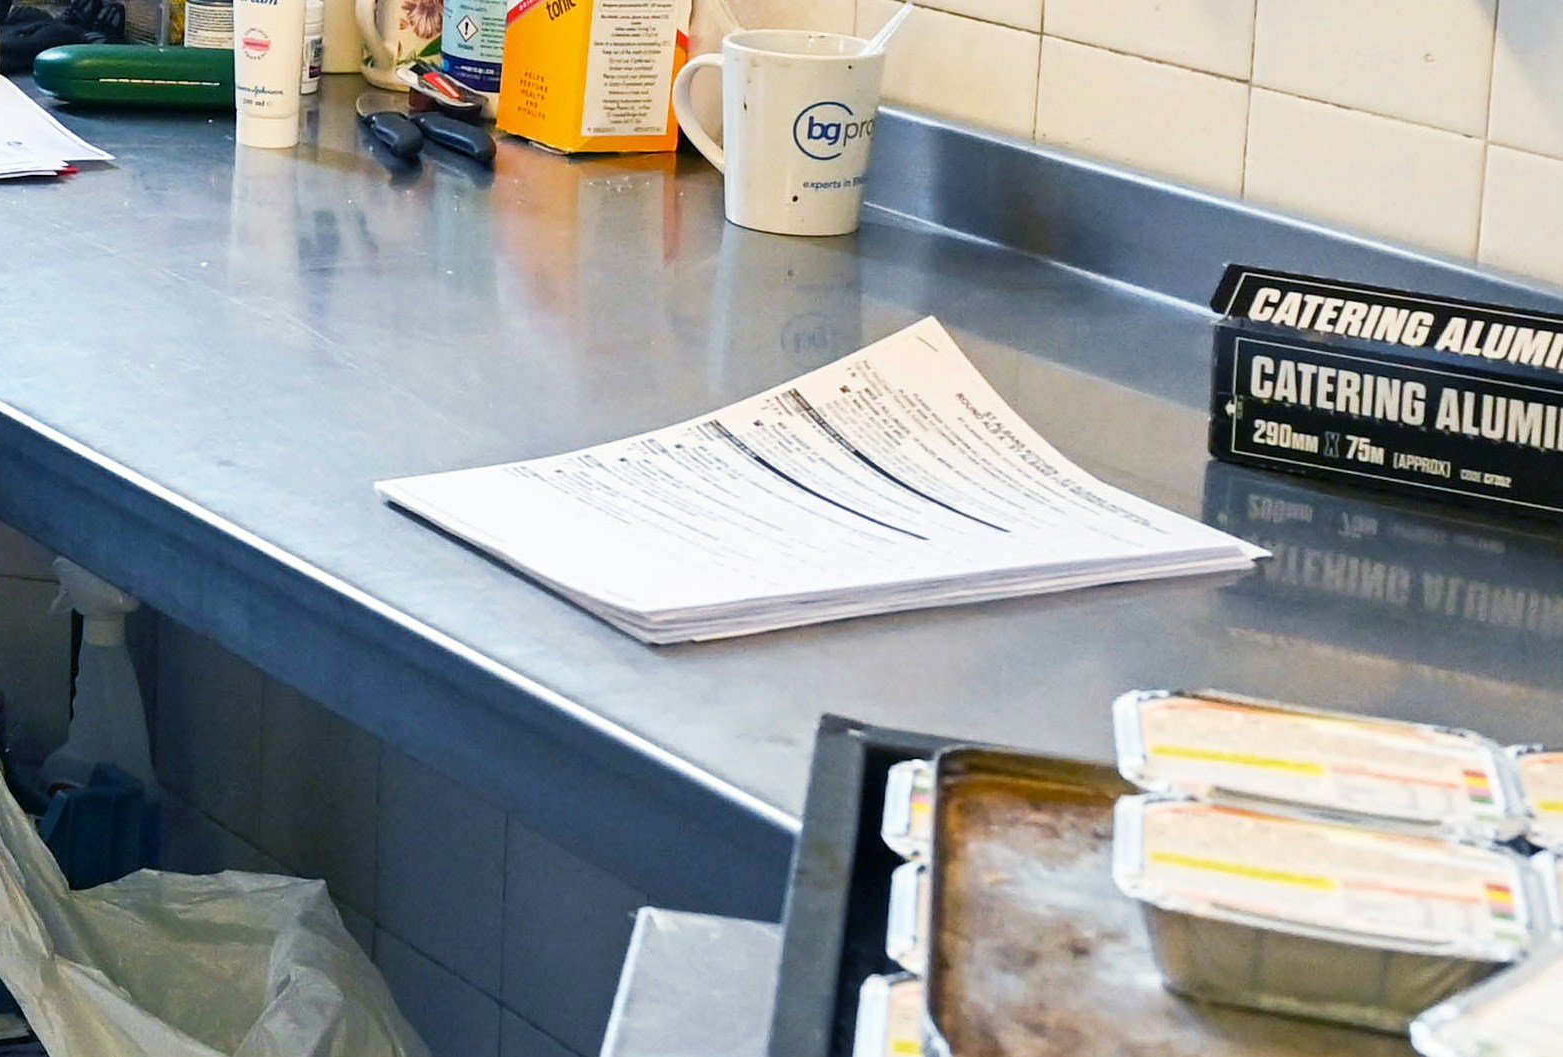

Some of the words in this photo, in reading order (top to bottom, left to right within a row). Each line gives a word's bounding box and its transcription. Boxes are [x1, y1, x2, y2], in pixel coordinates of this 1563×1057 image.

[803, 180, 841, 192] experts
[1248, 287, 1434, 347] CATERING
[955, 392, 982, 420] ROUND
[1250, 355, 1426, 426] CATERING
